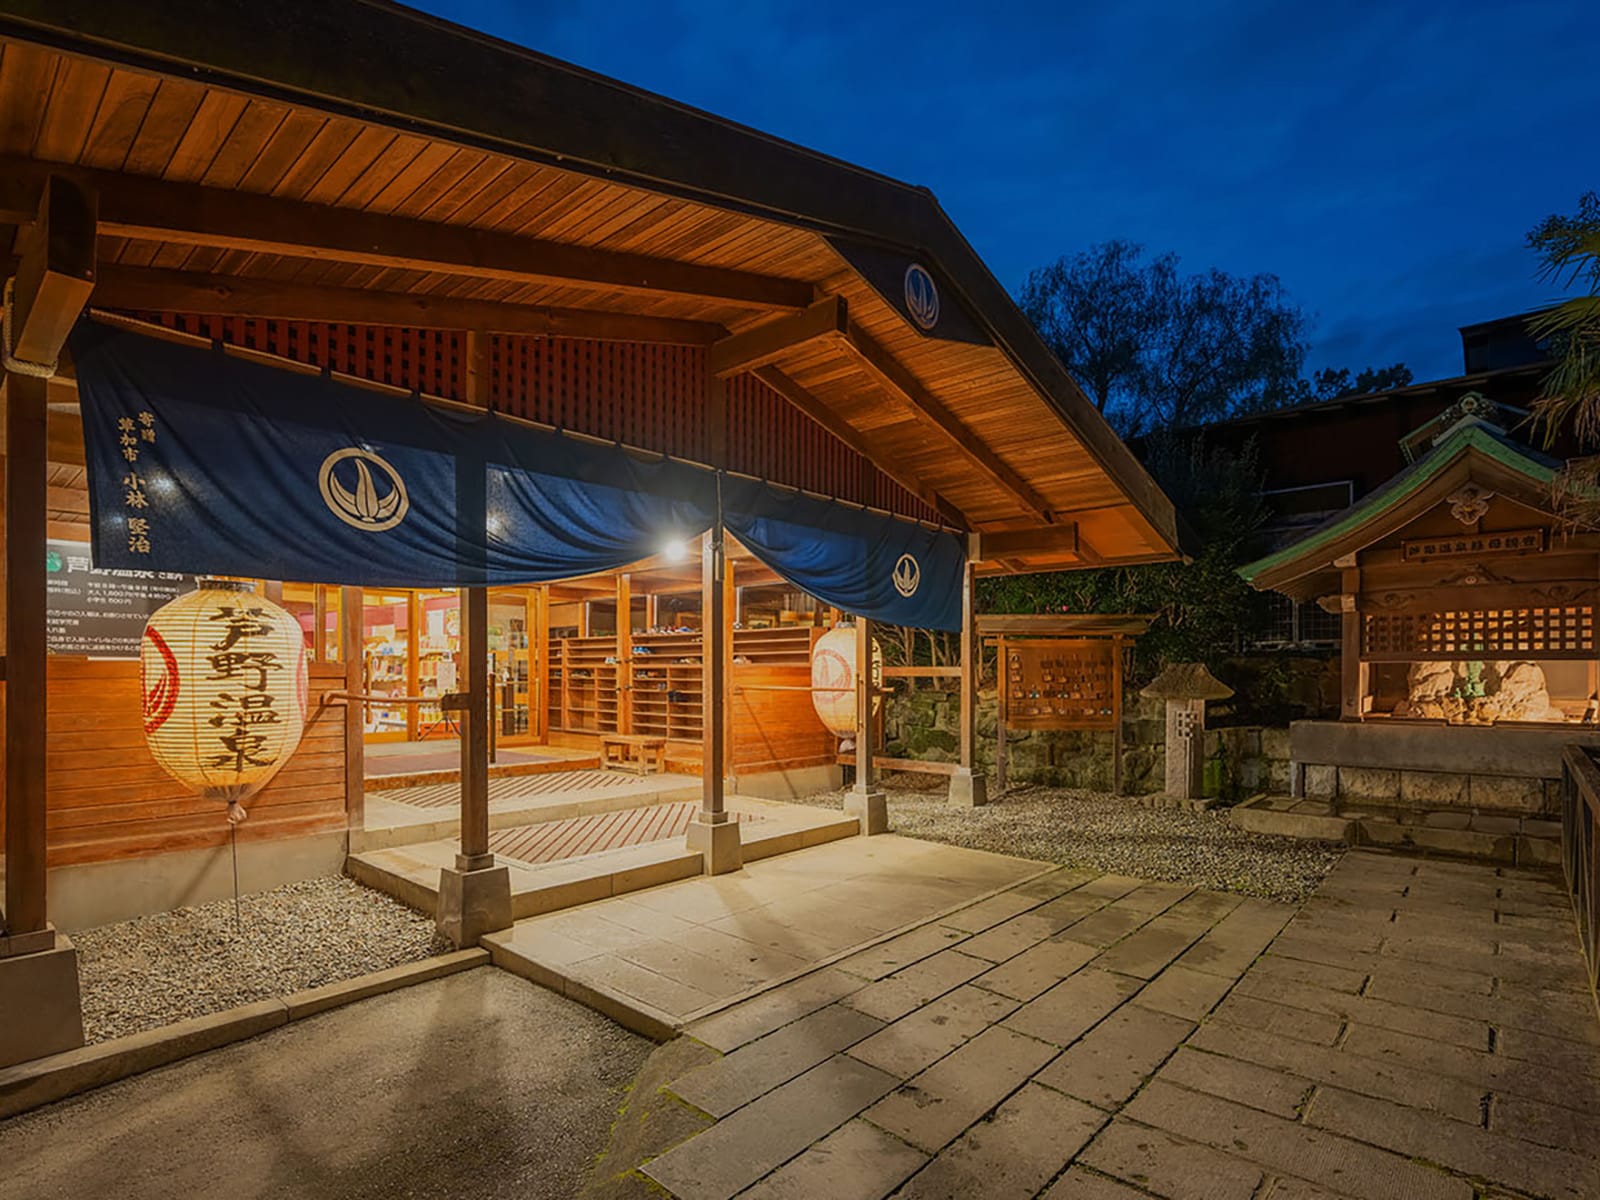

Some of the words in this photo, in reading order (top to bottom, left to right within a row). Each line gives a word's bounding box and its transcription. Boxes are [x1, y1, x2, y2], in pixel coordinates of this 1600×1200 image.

[123, 472, 149, 509] 小林
[206, 606, 284, 773] 芦野温泉
